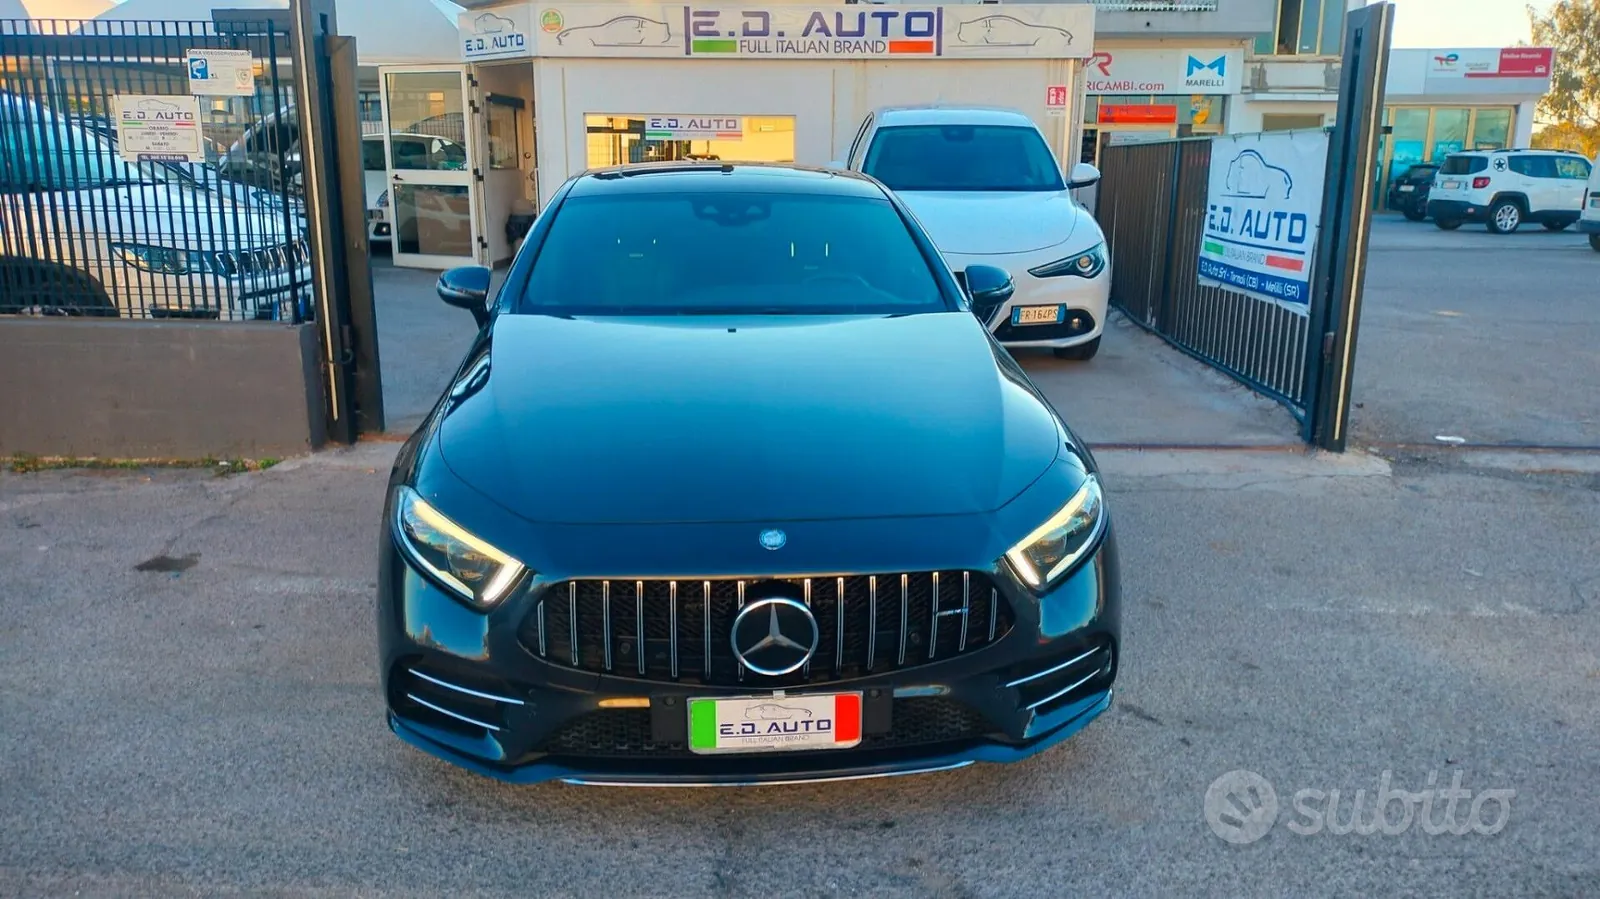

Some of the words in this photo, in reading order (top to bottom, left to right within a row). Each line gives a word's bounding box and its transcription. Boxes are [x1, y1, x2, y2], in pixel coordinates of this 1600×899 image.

[692, 10, 785, 37] E.D.
[801, 10, 935, 37] AUTO
[465, 39, 488, 51] E.D.
[492, 33, 524, 49] AUTO
[740, 40, 773, 53] FULL
[775, 40, 832, 53] ITALIAN
[834, 40, 886, 53] BRAND
[1186, 79, 1224, 87] MARELLI
[123, 111, 150, 119] E.D.
[156, 112, 193, 120] AUTO
[651, 118, 684, 128] E.D.
[687, 119, 737, 129] AUTO
[1209, 204, 1234, 234] E.D.
[1239, 209, 1307, 244] AUTO
[1284, 282, 1300, 299] (SR)
[720, 722, 761, 735] E.D.
[767, 719, 831, 733] AUTO
[741, 736, 759, 744] FULL
[759, 735, 785, 743] ITALIAN
[785, 732, 809, 742] BRAND
